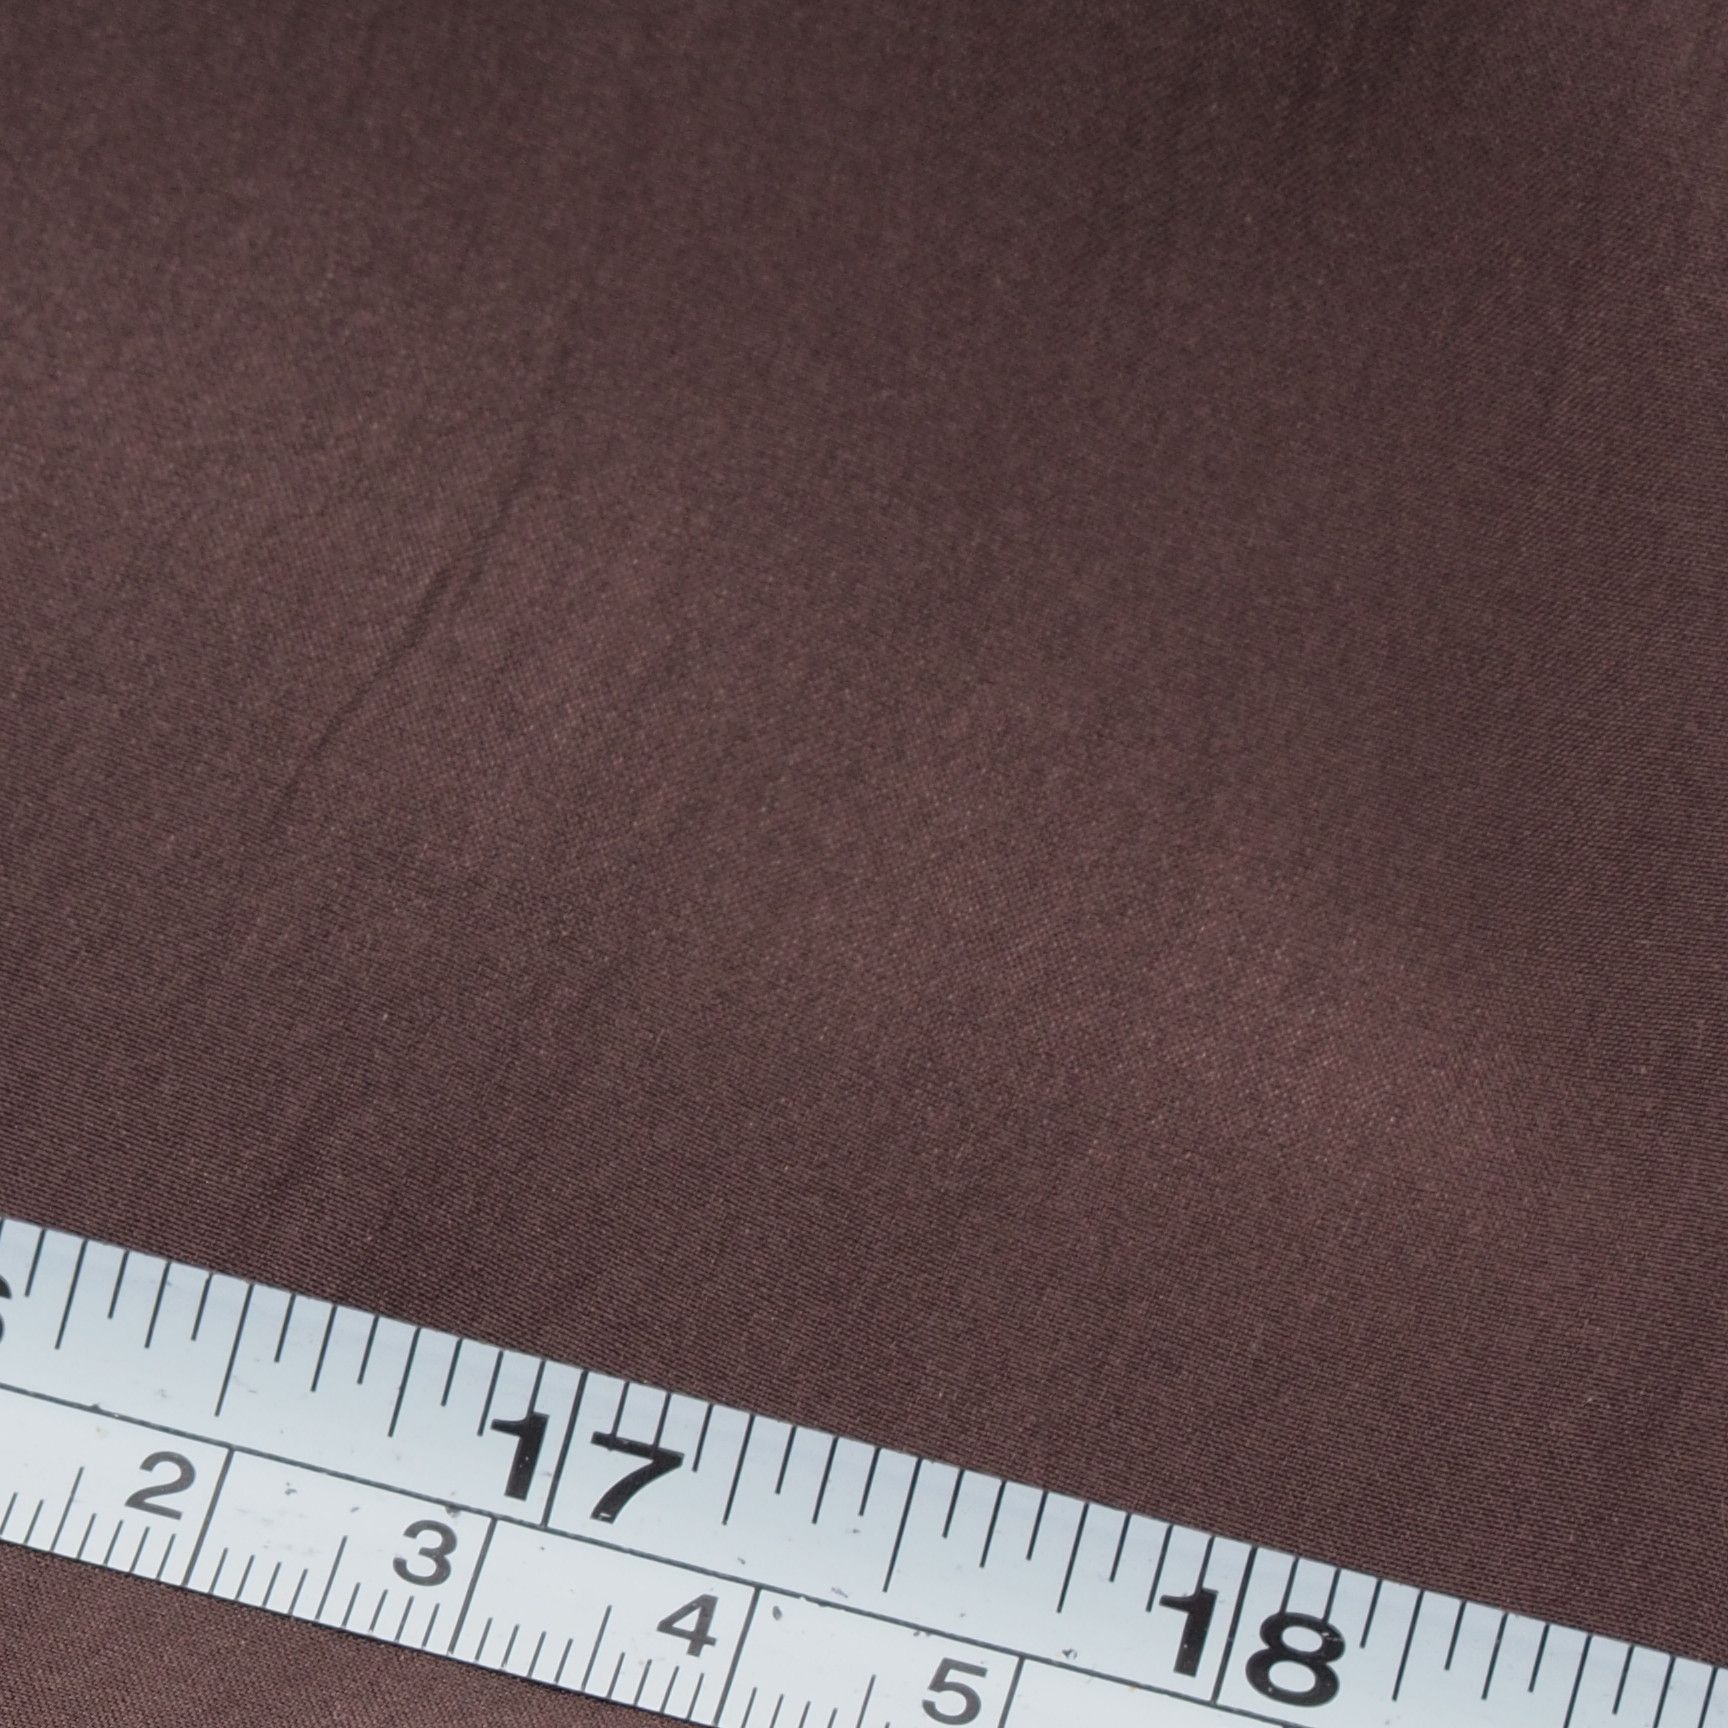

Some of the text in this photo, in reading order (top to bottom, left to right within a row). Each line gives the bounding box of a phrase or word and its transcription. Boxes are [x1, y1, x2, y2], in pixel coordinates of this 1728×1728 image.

[125, 1451, 196, 1520] 2
[392, 1520, 458, 1587] 3
[656, 1594, 718, 1658] 4
[921, 1657, 988, 1726] 5
[490, 1412, 685, 1523] 17
[1159, 1587, 1347, 1707] 18
